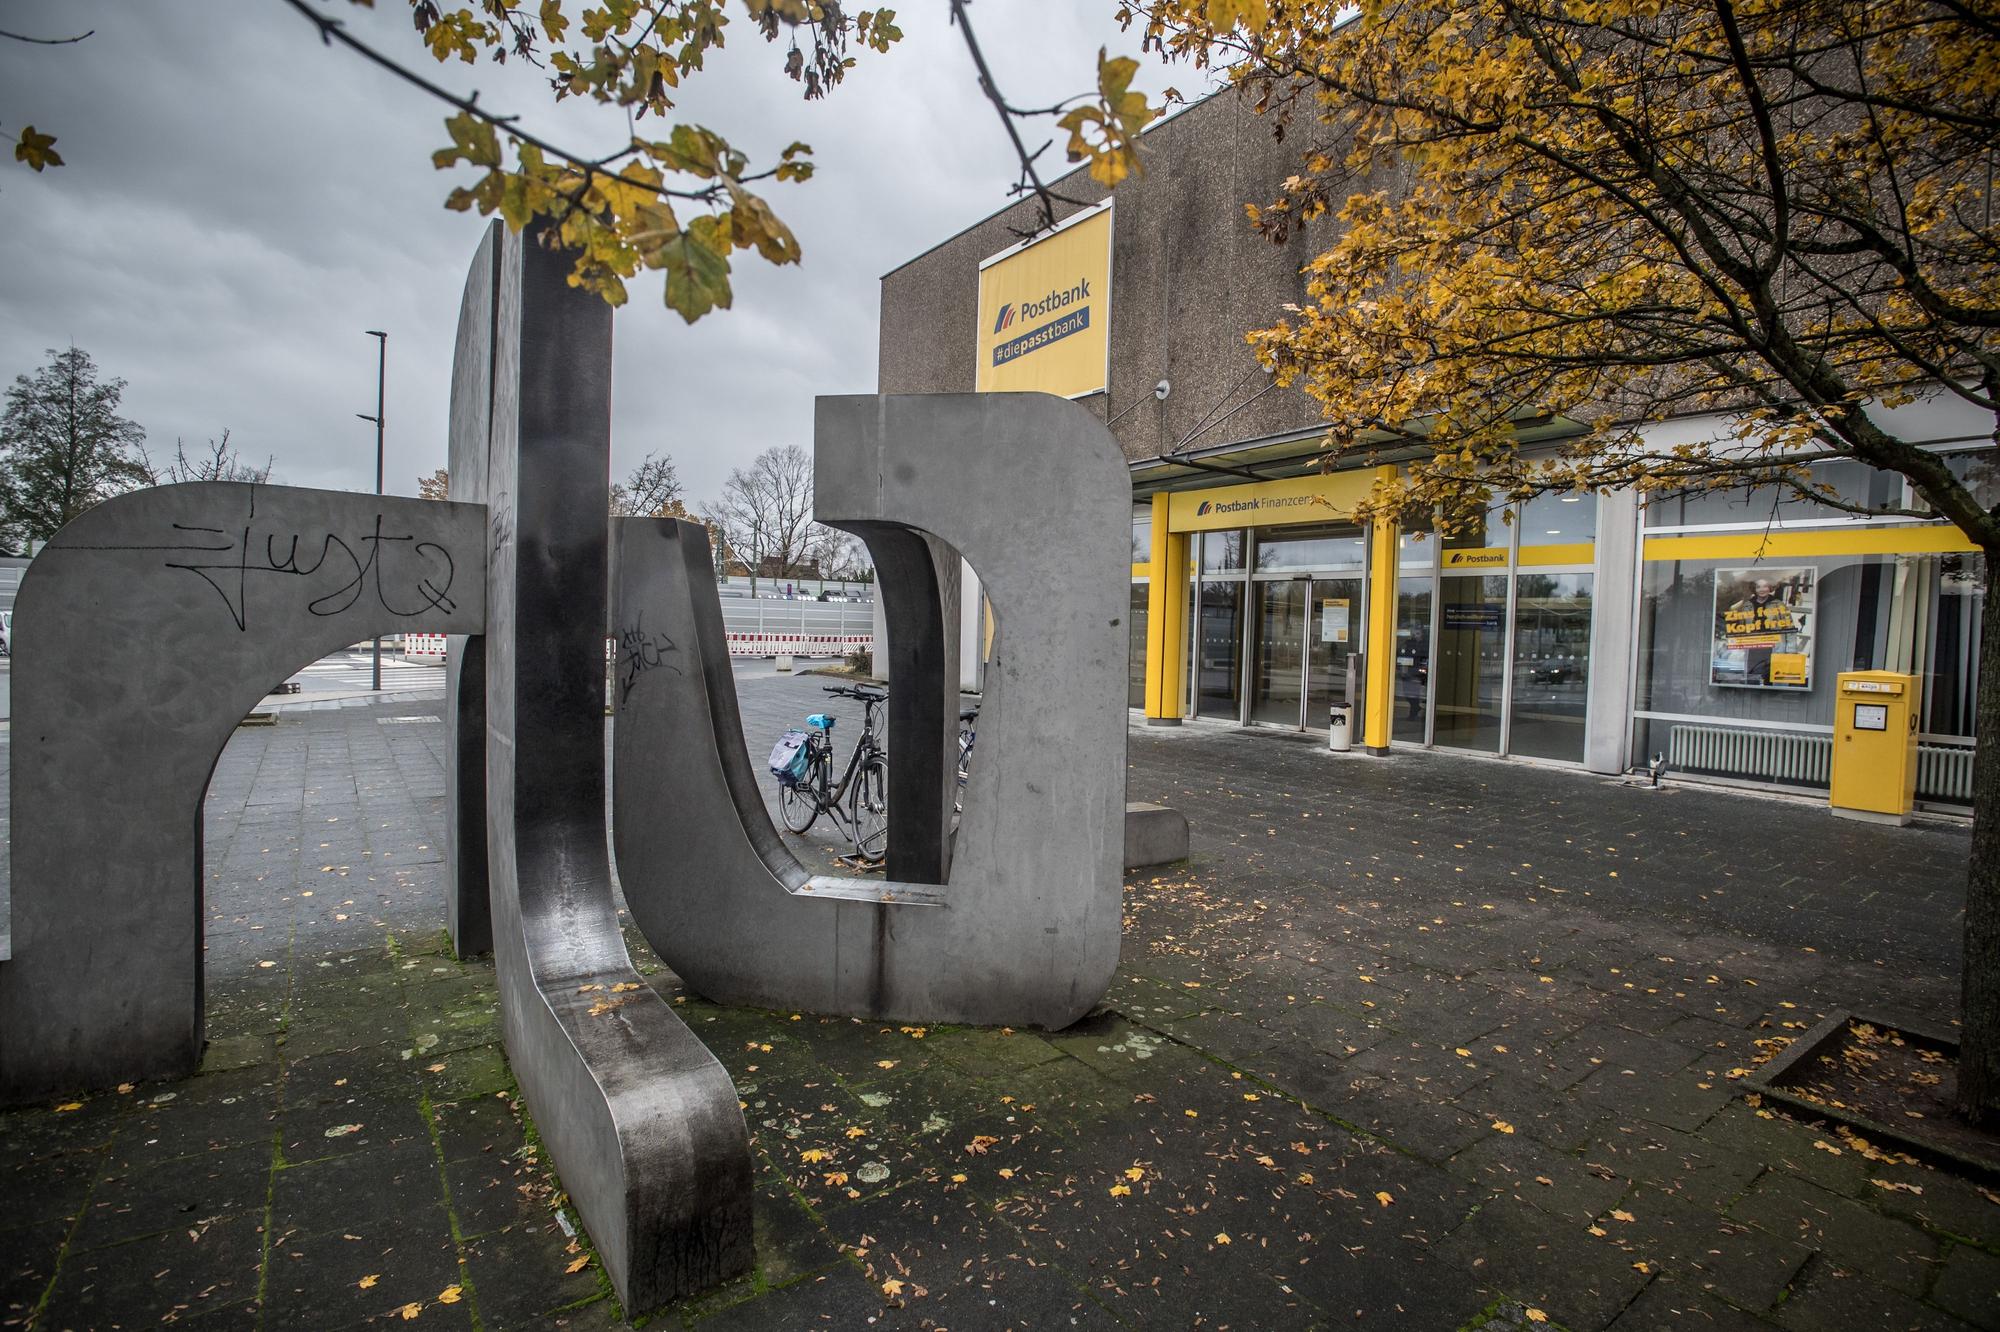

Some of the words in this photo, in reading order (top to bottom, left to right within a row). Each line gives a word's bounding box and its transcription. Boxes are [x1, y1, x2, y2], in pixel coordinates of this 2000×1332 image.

[1021, 278, 1090, 322] Postbank
[996, 314, 1084, 361] #diepasstbank
[1215, 498, 1259, 514] Postbank
[1466, 554, 1505, 563] Postbank
[1726, 620, 1762, 634] Kopf
